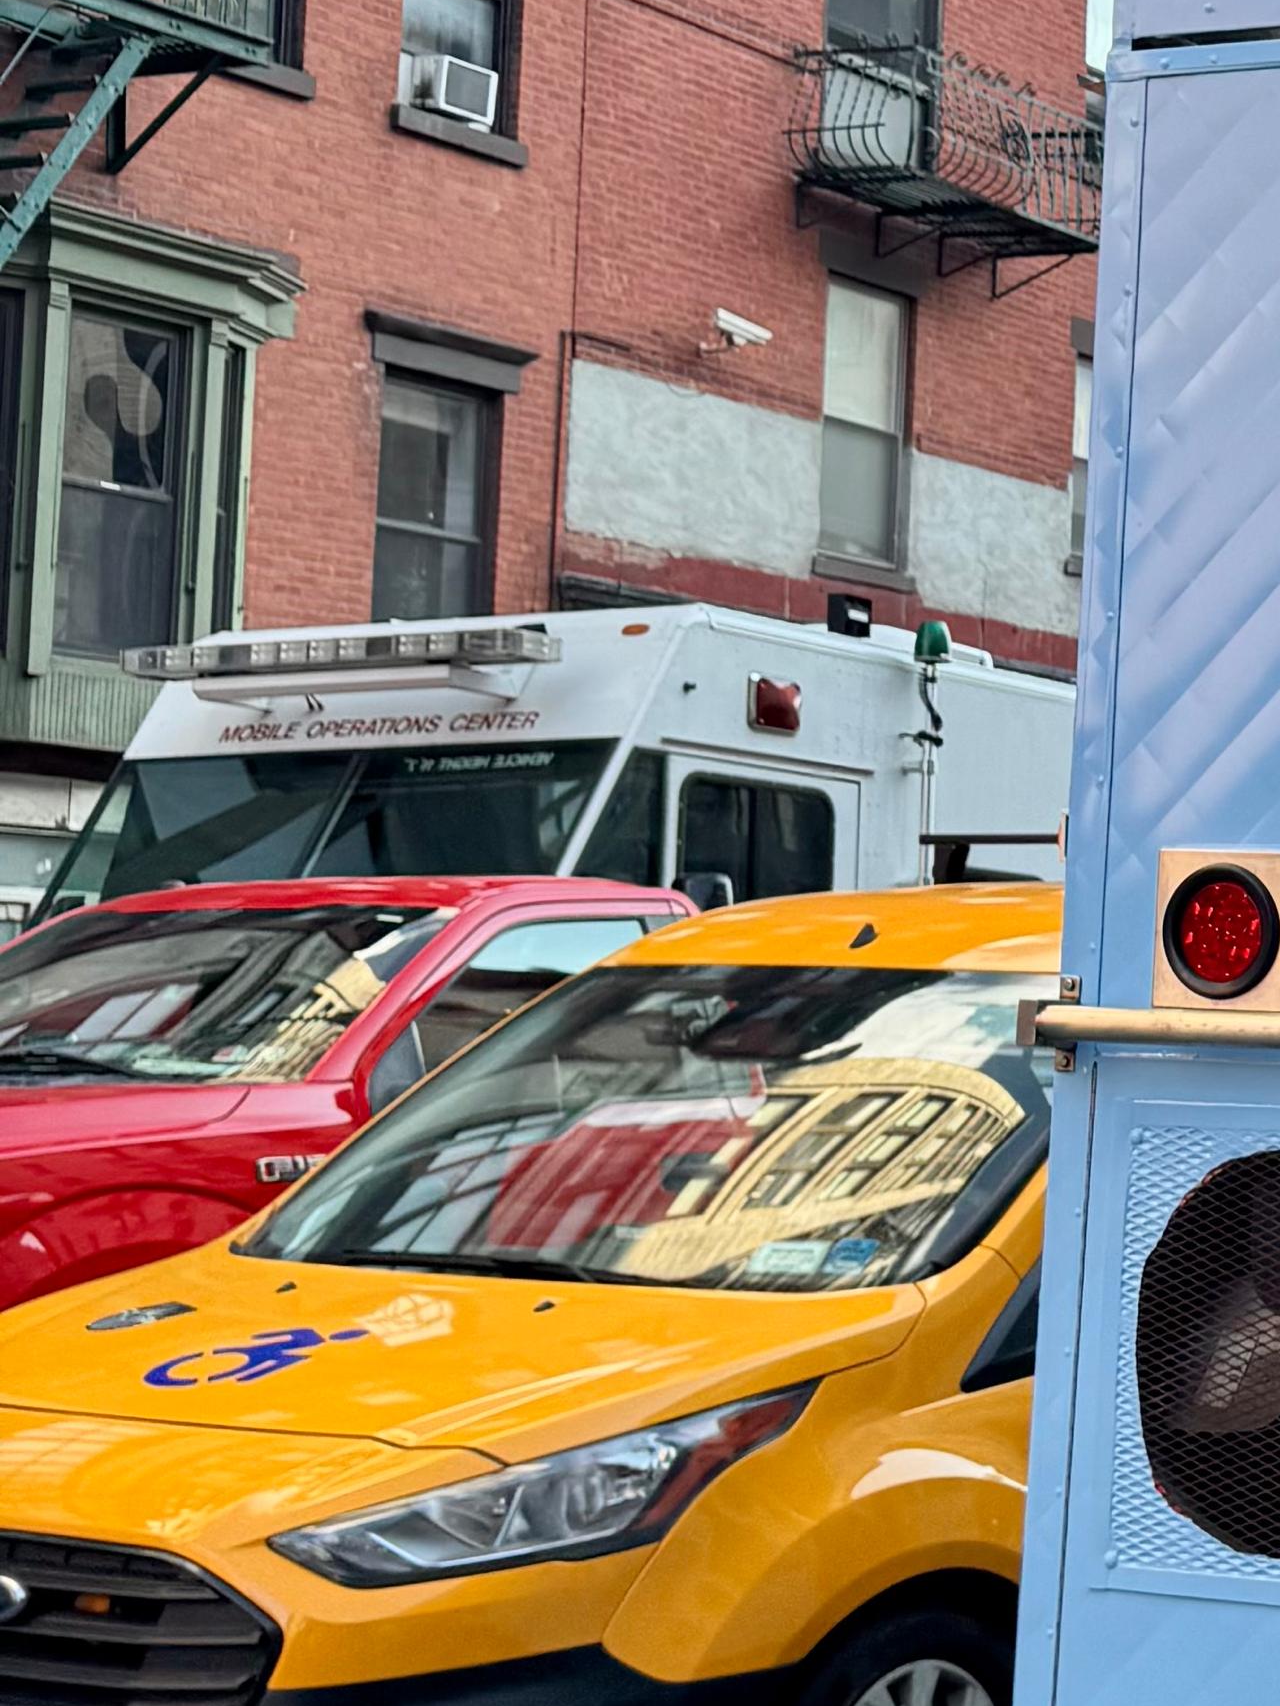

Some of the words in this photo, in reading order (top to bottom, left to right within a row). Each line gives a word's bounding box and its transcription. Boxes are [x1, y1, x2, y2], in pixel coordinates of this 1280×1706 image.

[218, 721, 300, 743] MOBILE
[306, 714, 443, 739] OPERATIONS
[449, 711, 540, 732] CENTER
